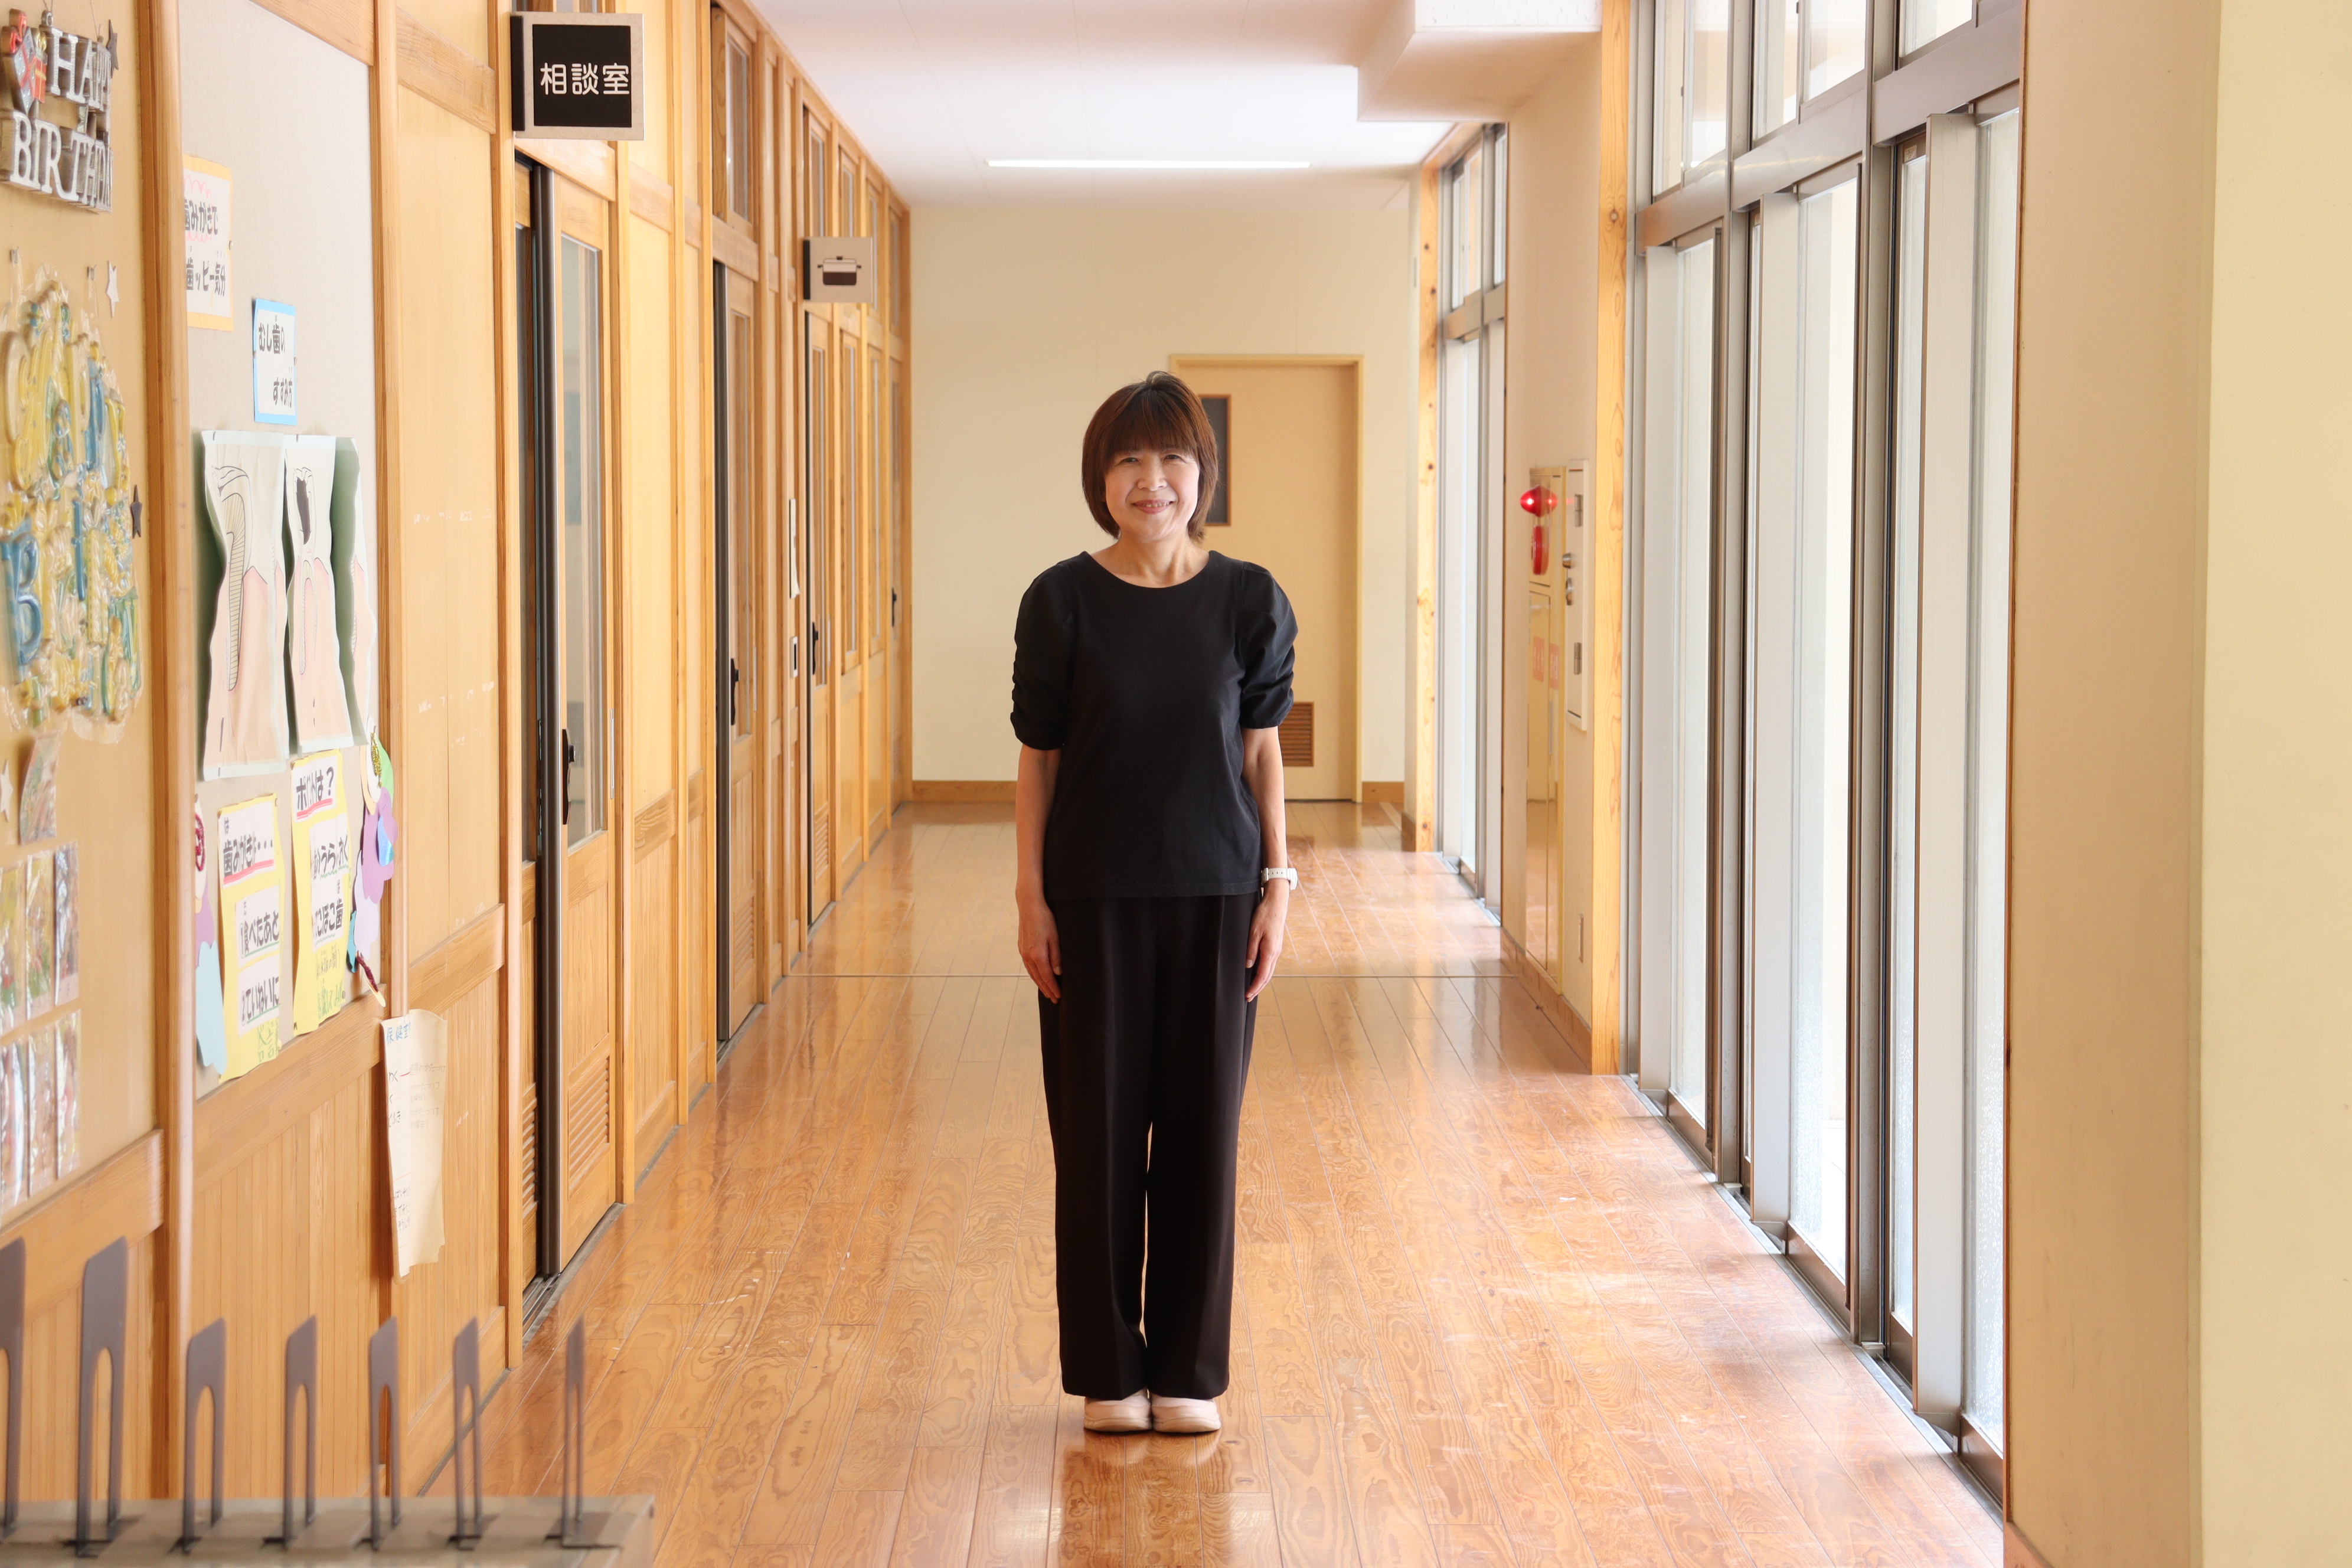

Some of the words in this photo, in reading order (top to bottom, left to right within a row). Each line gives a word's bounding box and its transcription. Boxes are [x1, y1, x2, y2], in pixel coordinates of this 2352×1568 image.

[540, 62, 630, 96] 相談室
[259, 322, 285, 354] むし歯の
[273, 377, 293, 408] すすみ方
